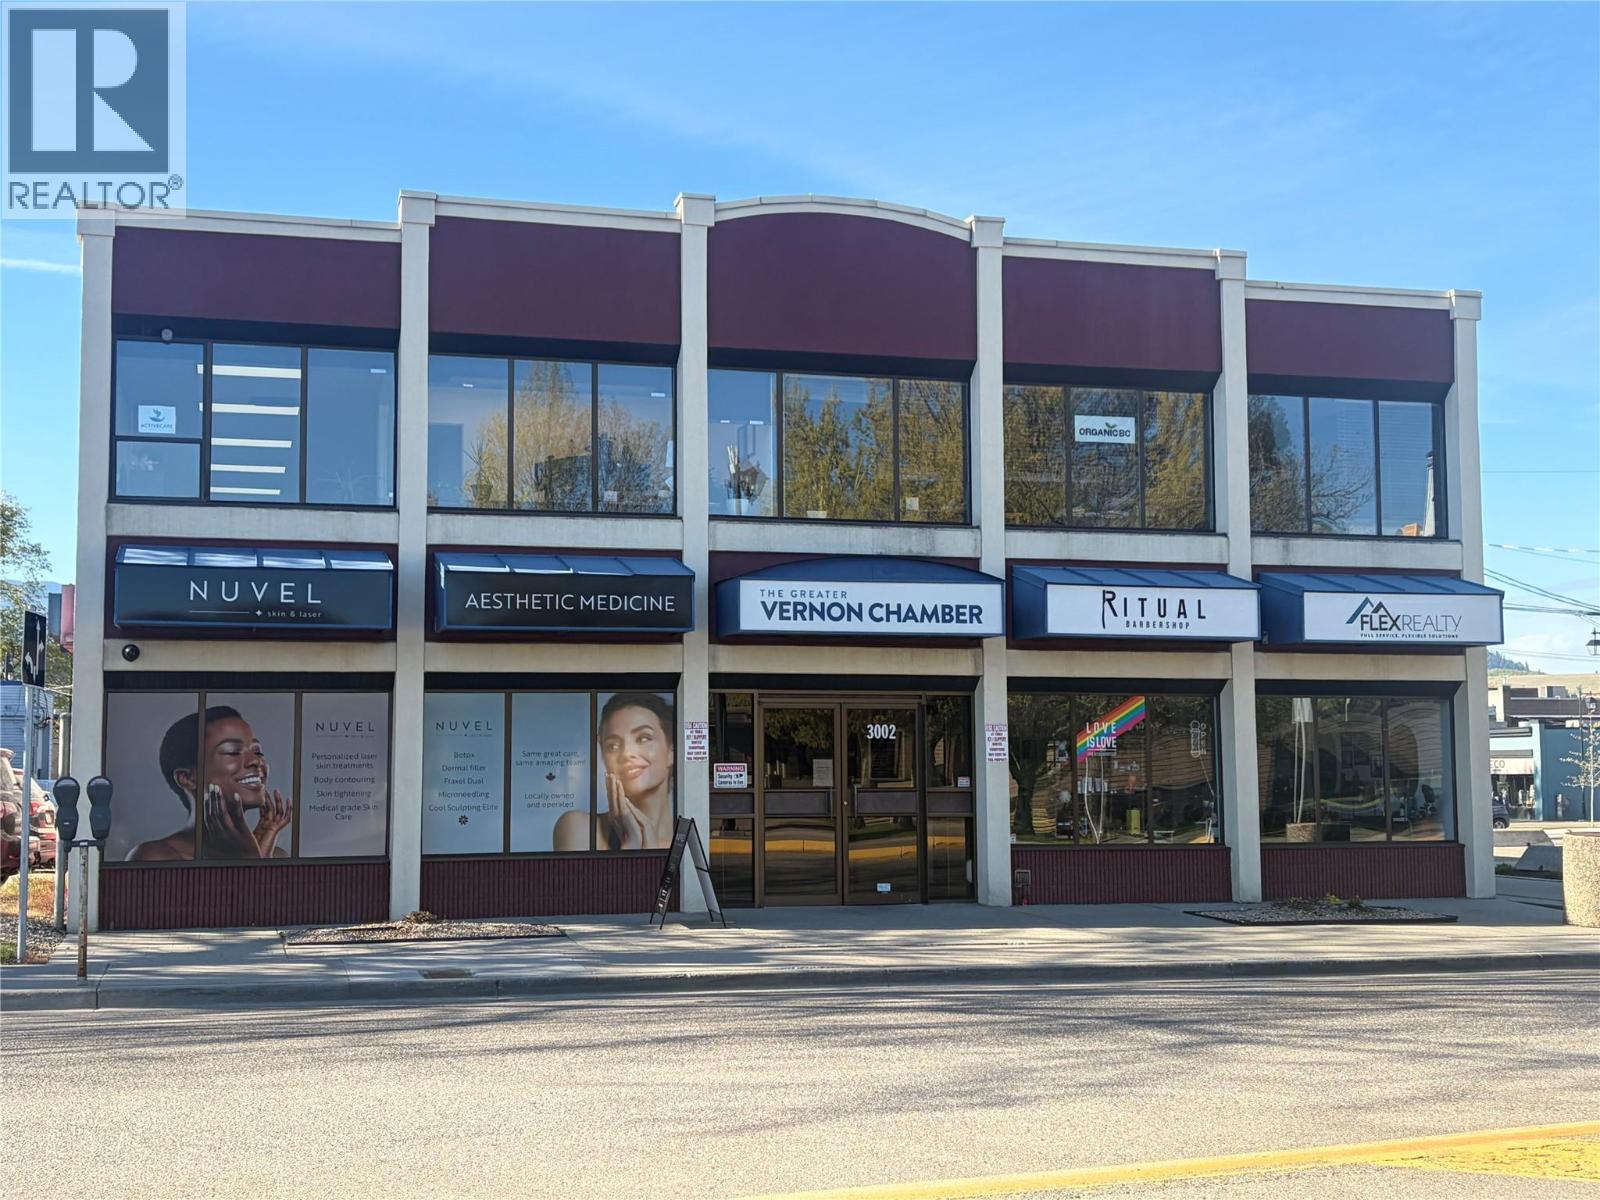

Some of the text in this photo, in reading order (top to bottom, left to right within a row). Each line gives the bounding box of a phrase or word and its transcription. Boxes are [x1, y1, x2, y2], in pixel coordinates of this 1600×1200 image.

[189, 580, 322, 605] NUVEL
[759, 588, 848, 600] THE GREATER
[464, 592, 676, 612] AESTHETIC MEDICINE
[760, 601, 983, 624] VERNON CHAMBER
[1102, 589, 1207, 629] RITUAL
[1126, 620, 1190, 630] BARBERSHOP
[315, 721, 376, 732] NUVEL
[435, 720, 494, 731] NUVEL
[1086, 722, 1116, 734] LOVE
[866, 724, 897, 740] 3002
[1086, 736, 1117, 748] IS LOVE
[311, 752, 359, 760] Personalized
[521, 750, 542, 758] Same
[543, 751, 561, 759] great
[535, 760, 565, 768] amazing
[313, 776, 333, 784] Body
[334, 790, 372, 798] tightening
[438, 791, 490, 799] Microneedling
[340, 804, 362, 813] grade
[447, 804, 481, 812] Sculpting
